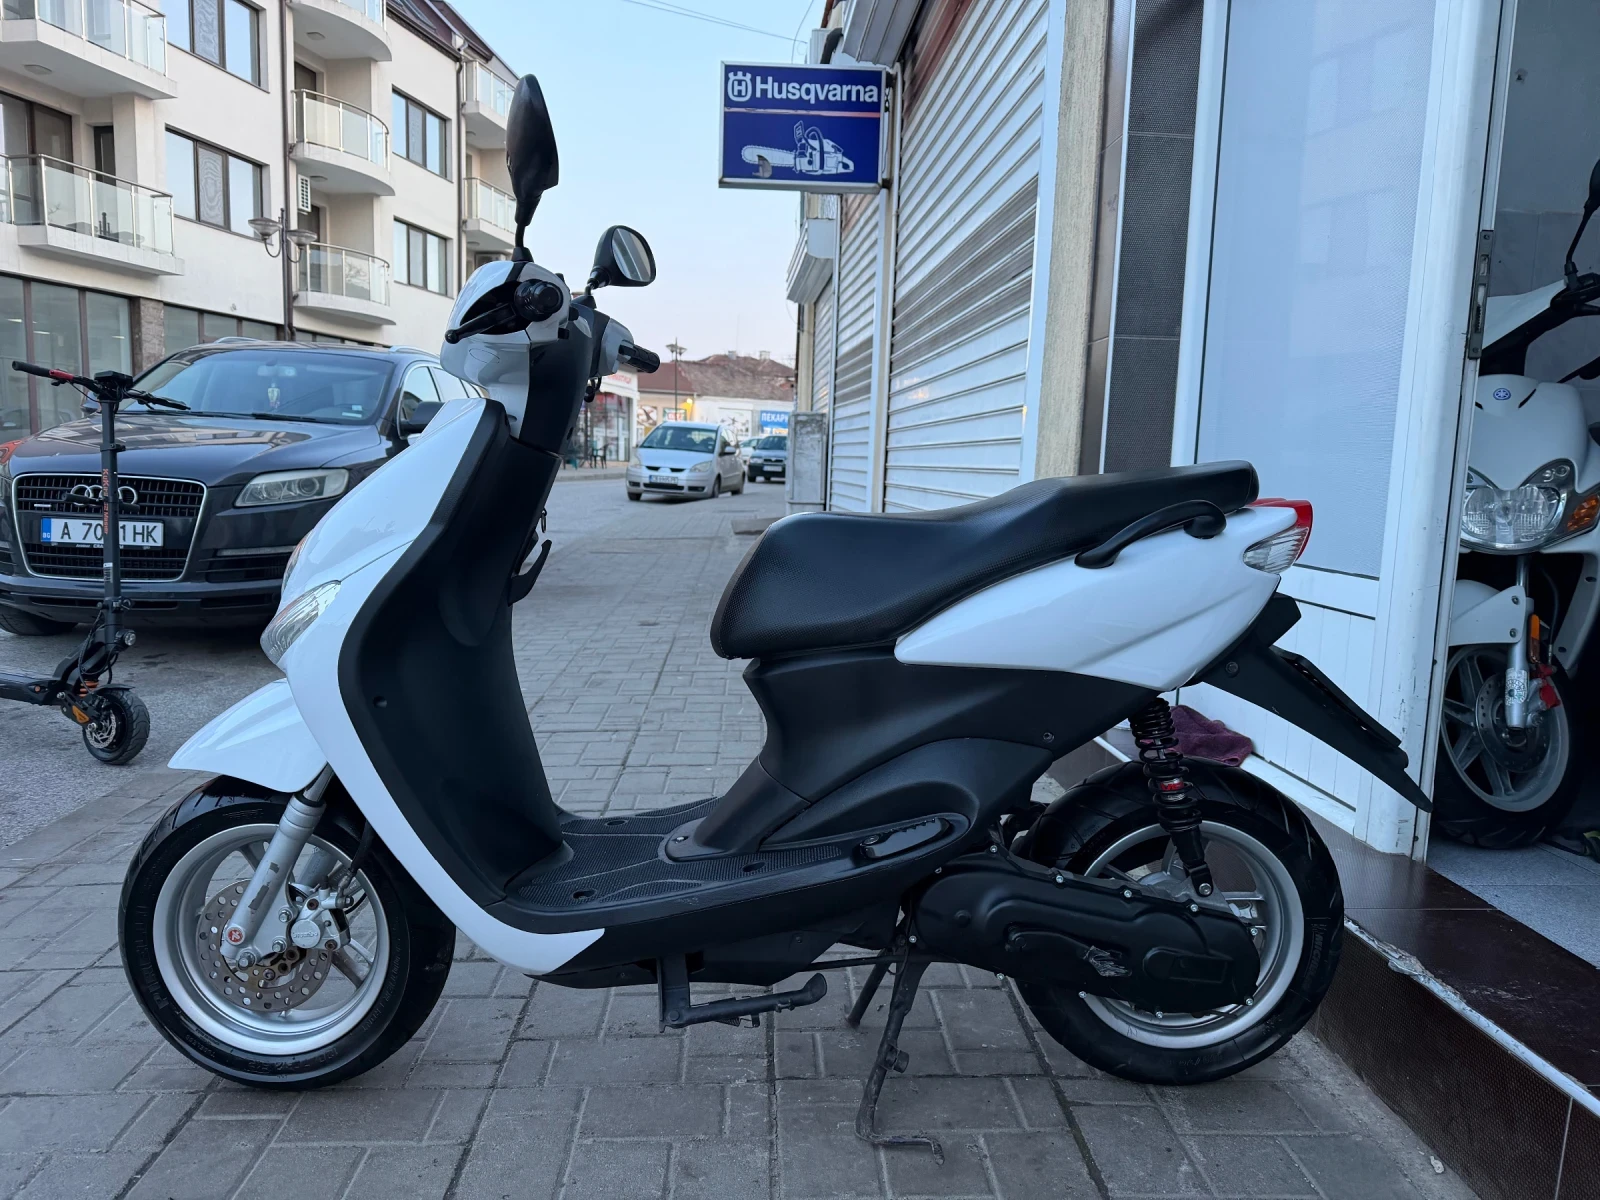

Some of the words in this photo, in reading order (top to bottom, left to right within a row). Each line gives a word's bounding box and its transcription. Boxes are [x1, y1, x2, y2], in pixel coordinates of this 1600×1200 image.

[755, 75, 879, 104] Husqvarna
[60, 521, 72, 539] A
[82, 522, 127, 542] 701
[132, 524, 158, 543] HK
